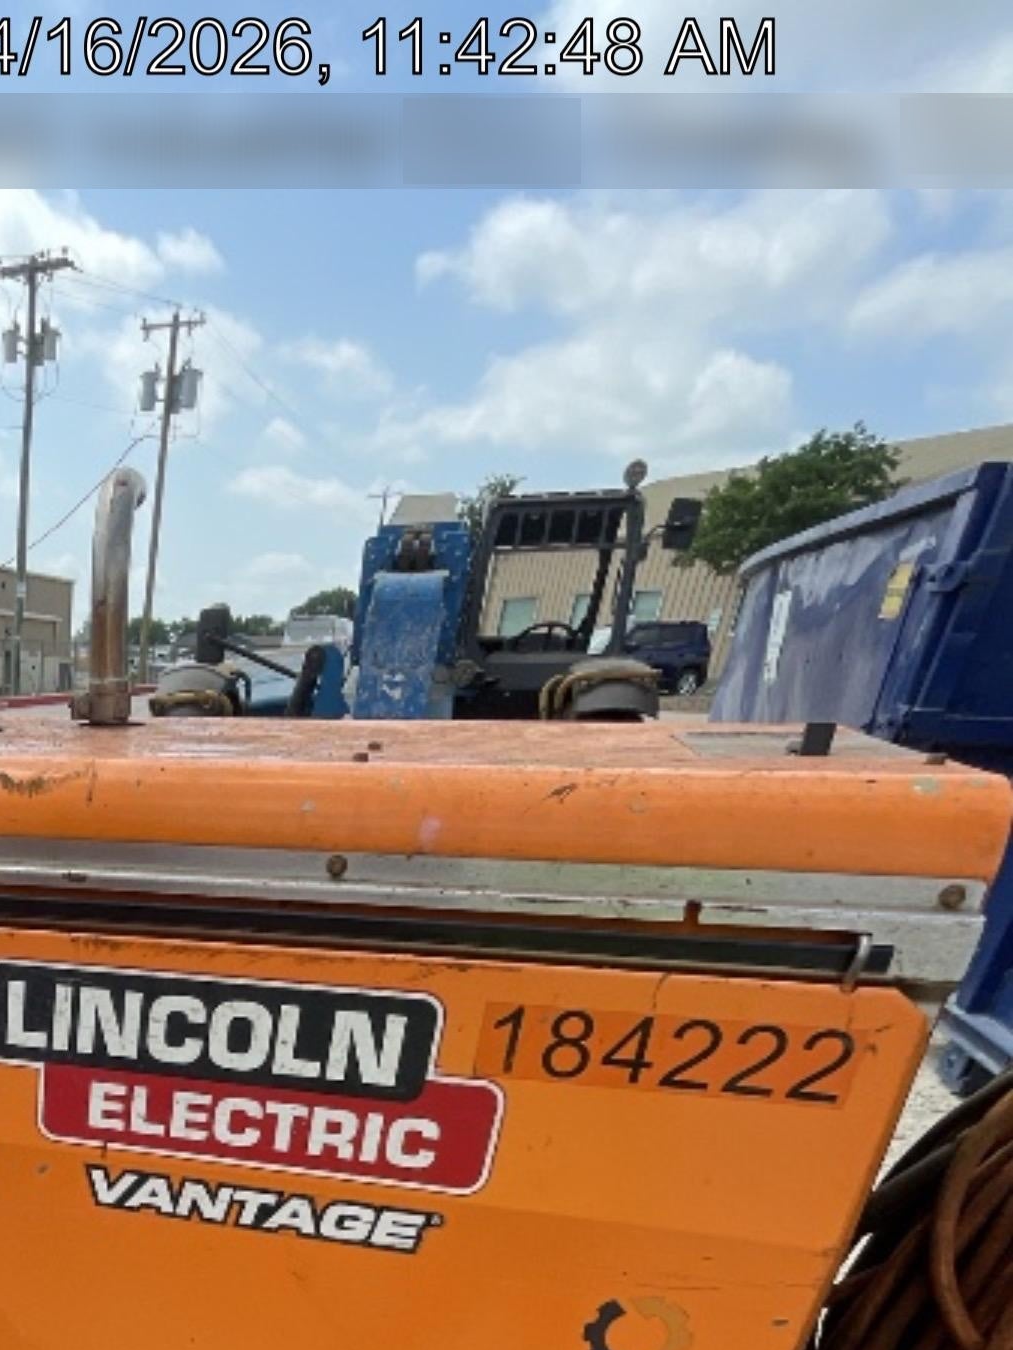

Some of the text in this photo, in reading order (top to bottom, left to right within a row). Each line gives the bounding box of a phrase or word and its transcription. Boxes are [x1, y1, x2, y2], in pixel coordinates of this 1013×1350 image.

[5, 979, 408, 1087] LINCOLN
[493, 1004, 856, 1104] 184222
[88, 1080, 441, 1169] ELECTRIC
[85, 1165, 429, 1253] VANTAGE
